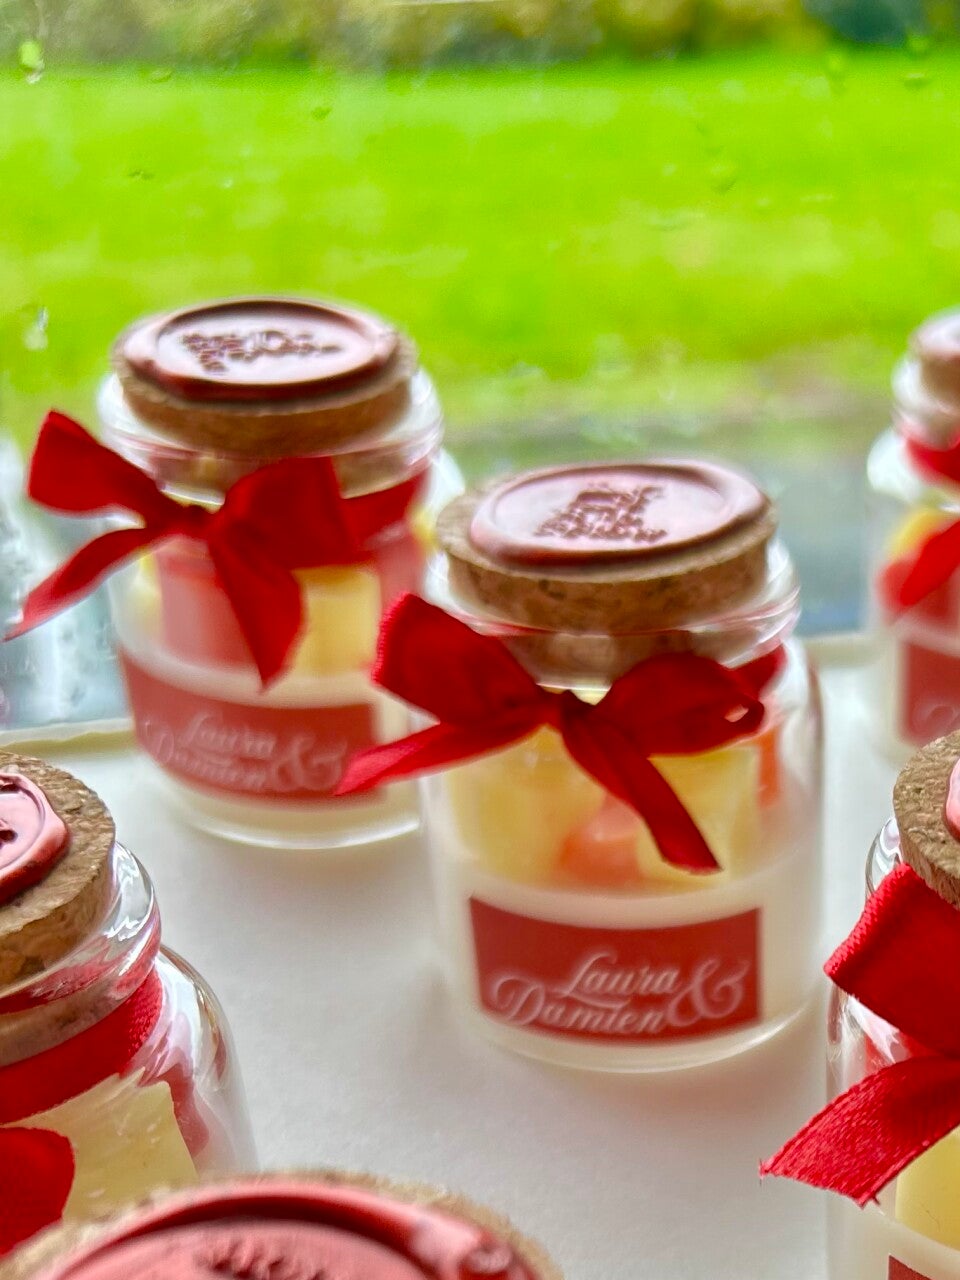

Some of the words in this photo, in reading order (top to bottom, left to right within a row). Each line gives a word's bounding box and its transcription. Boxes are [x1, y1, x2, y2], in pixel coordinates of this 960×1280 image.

[491, 975, 668, 1034] Damien
[551, 950, 682, 1010] Laura
[665, 958, 751, 1028] &
